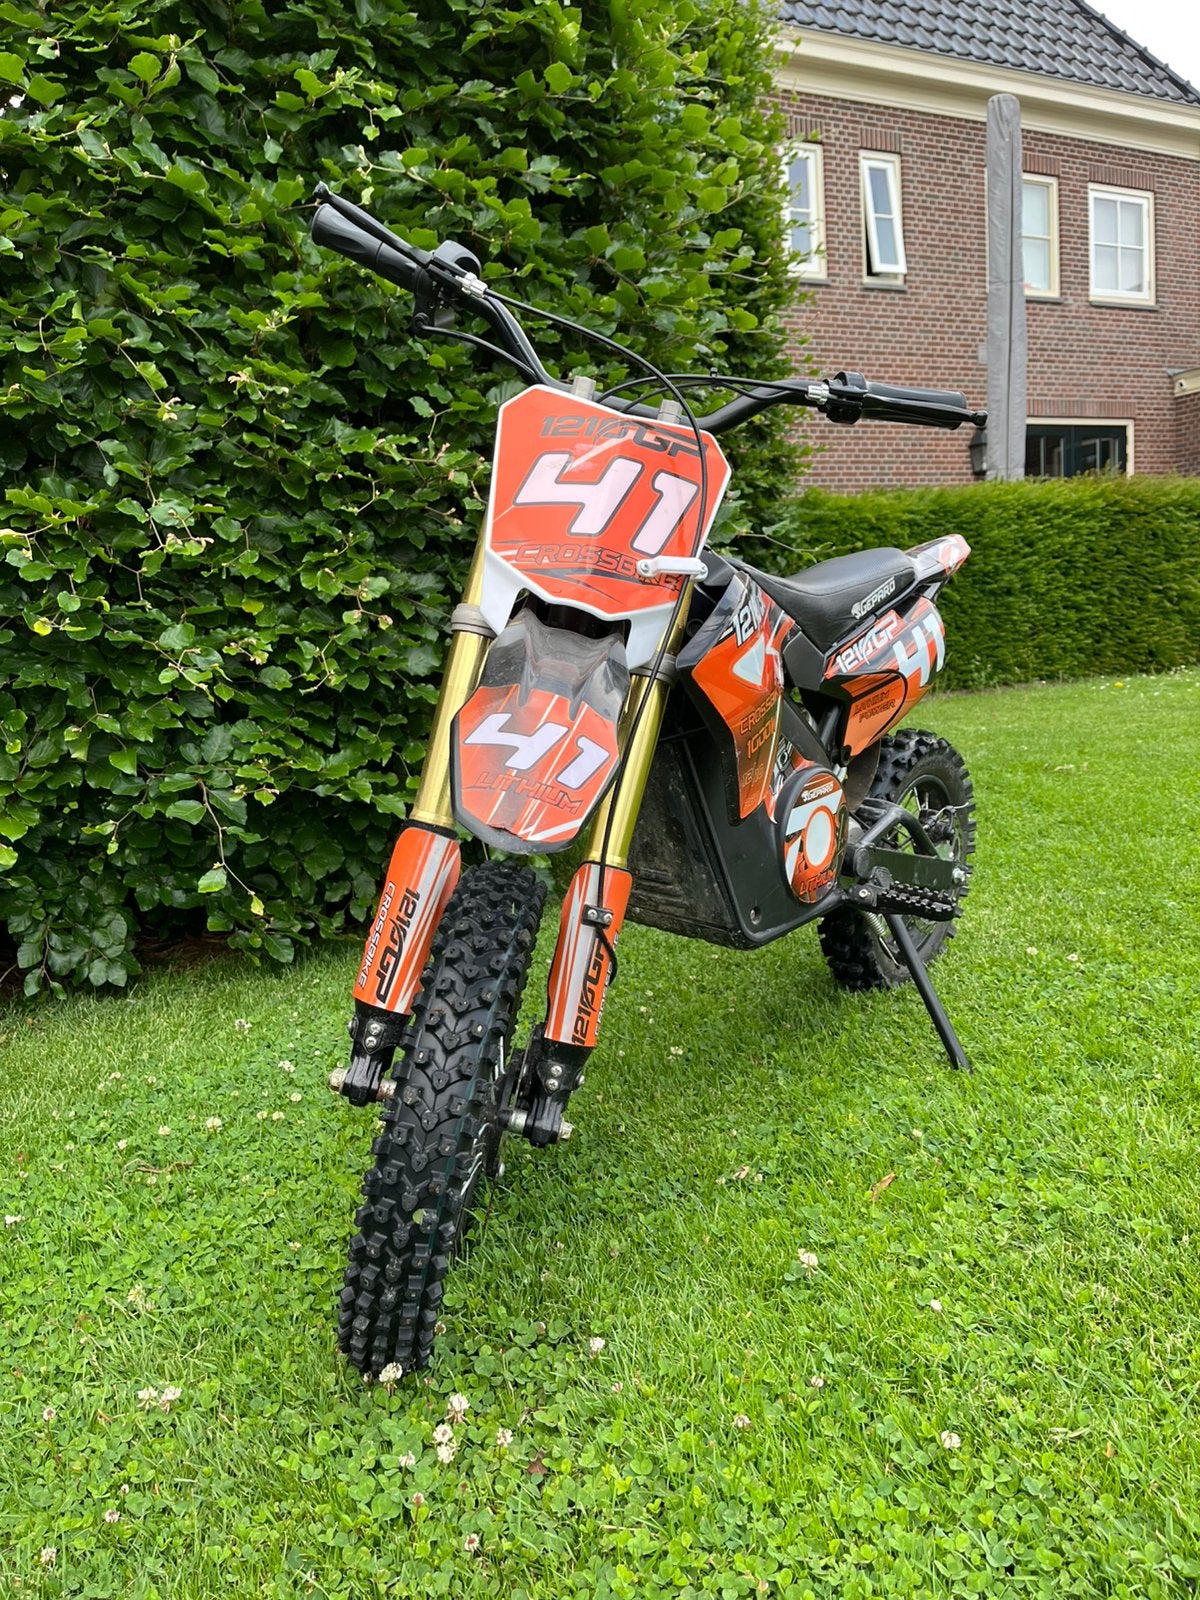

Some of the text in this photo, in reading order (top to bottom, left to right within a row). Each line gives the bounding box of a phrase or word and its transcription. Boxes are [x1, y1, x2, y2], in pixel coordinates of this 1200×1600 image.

[513, 451, 700, 558] 41
[860, 575, 896, 617] GEPARD
[892, 612, 945, 688] 41
[858, 699, 896, 724] POWER
[463, 712, 611, 791] 41
[472, 771, 584, 815] LITHIUM
[357, 880, 396, 990] CROSSBIKE
